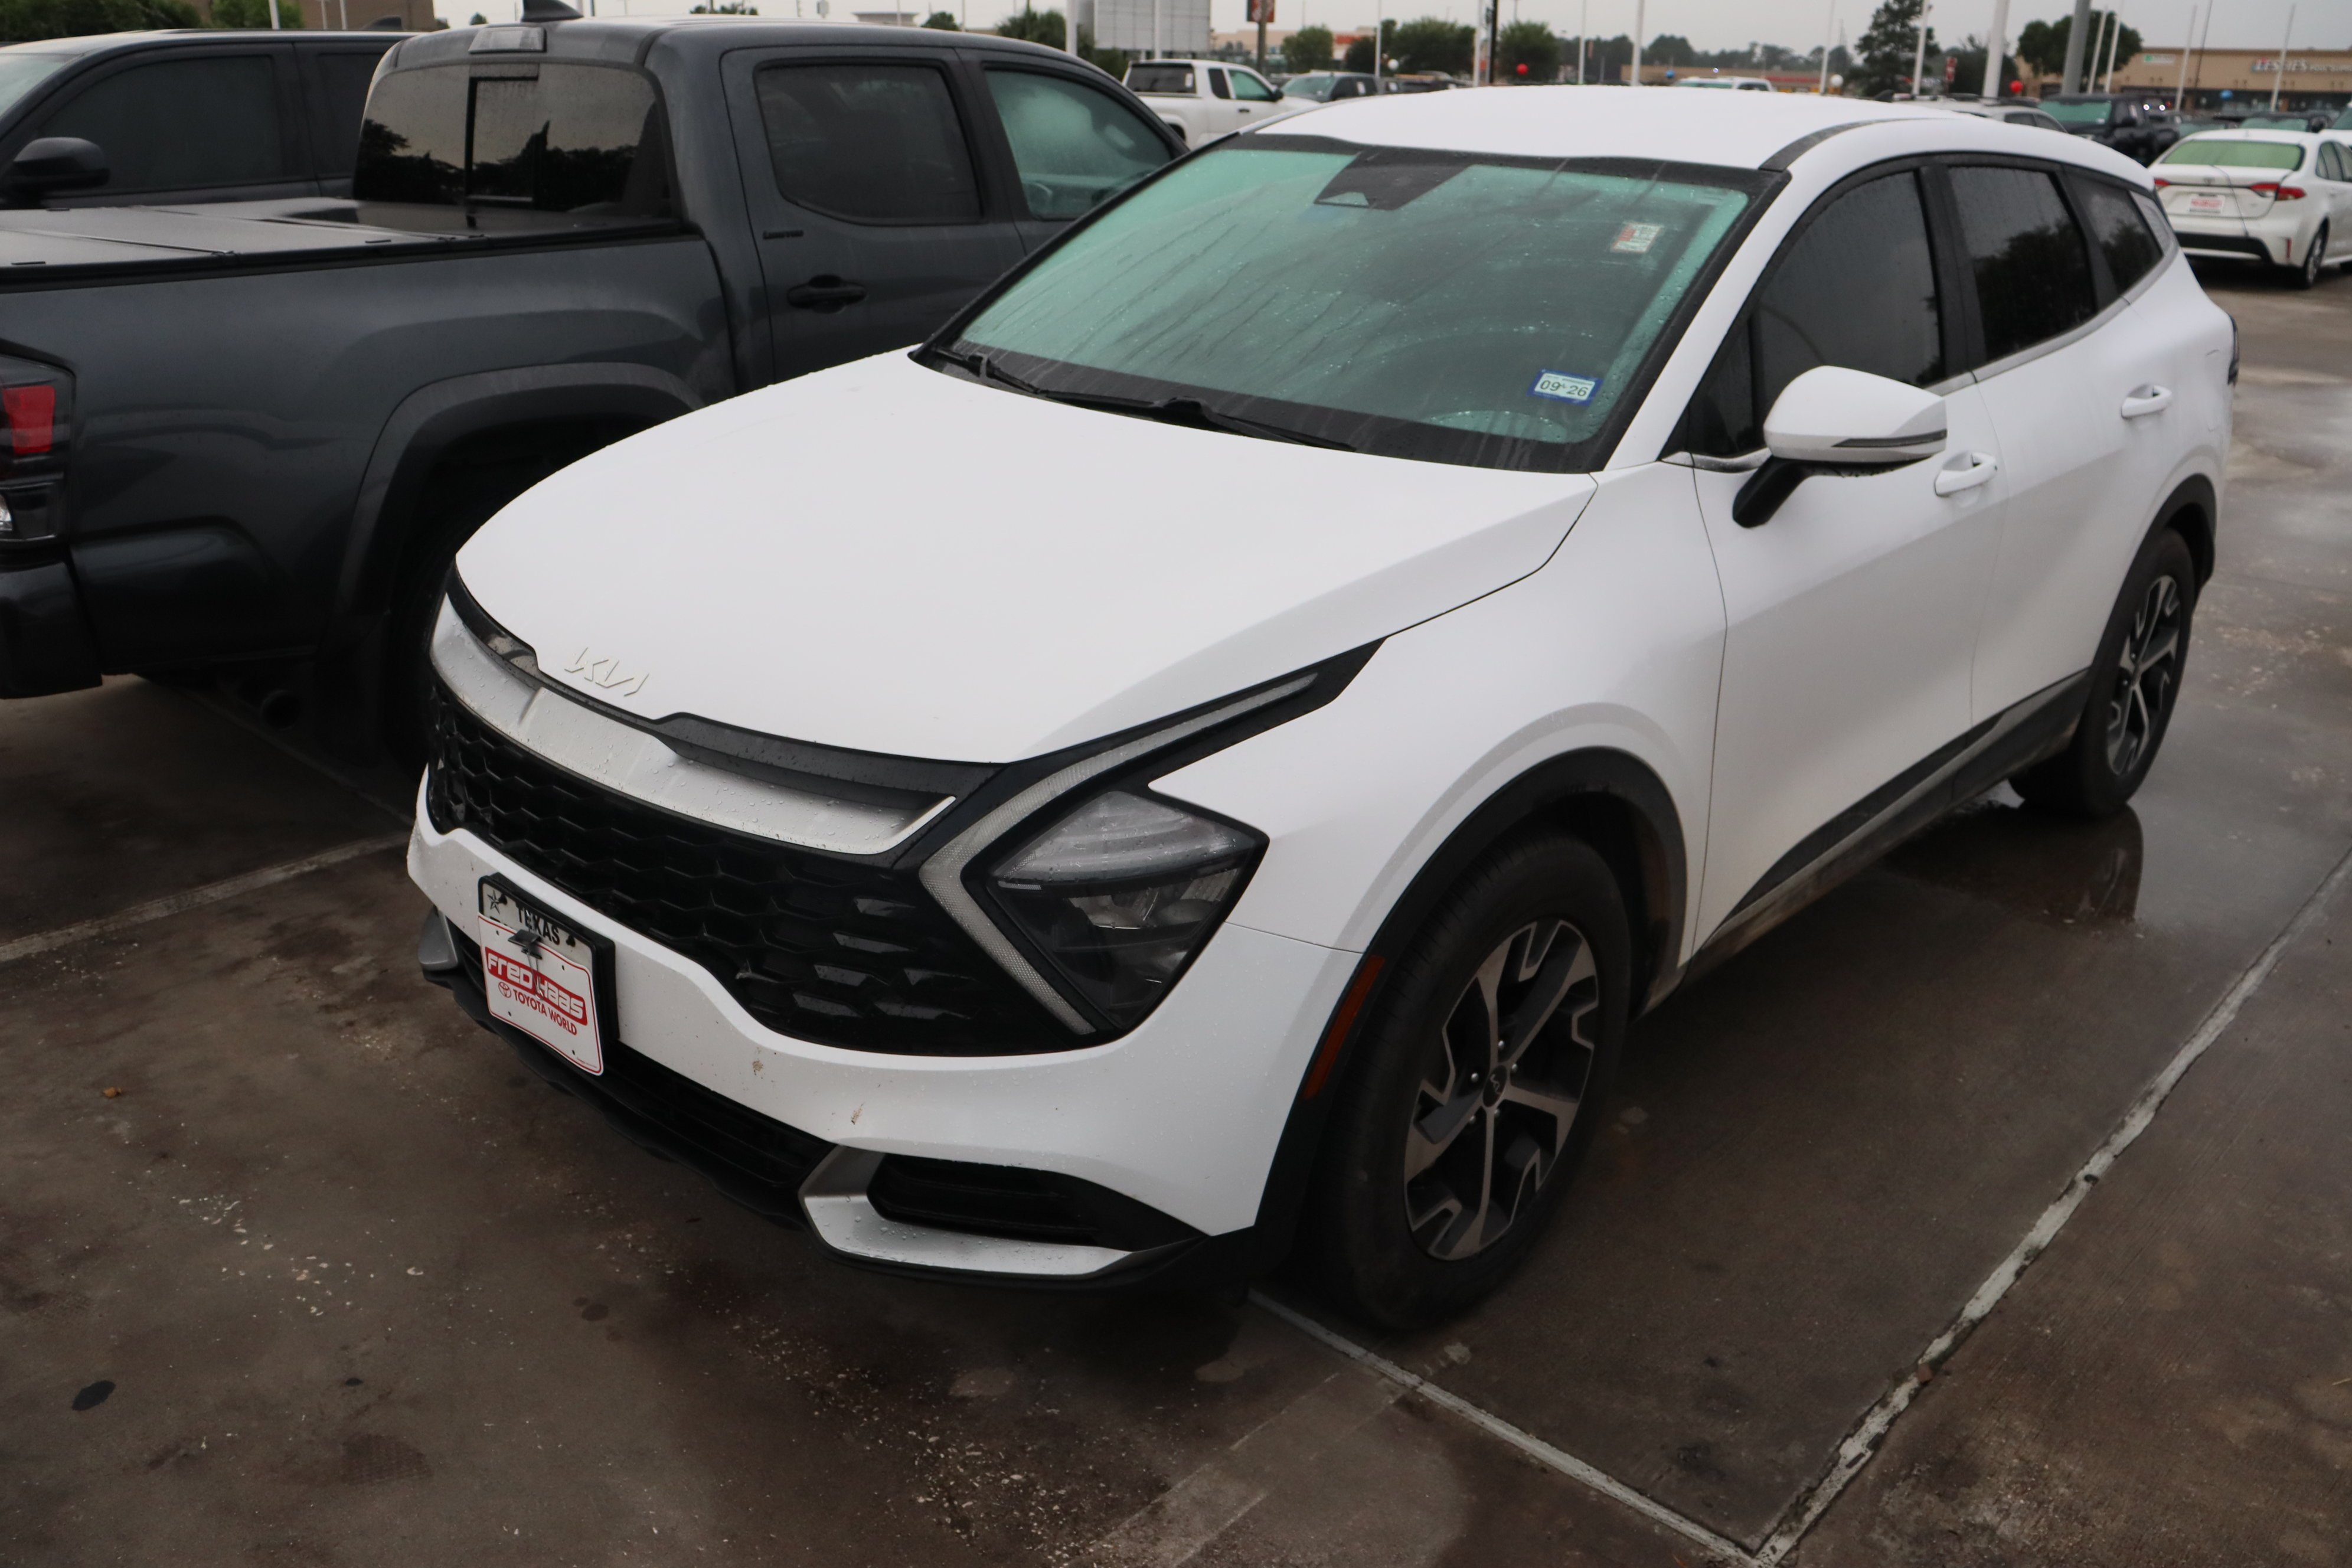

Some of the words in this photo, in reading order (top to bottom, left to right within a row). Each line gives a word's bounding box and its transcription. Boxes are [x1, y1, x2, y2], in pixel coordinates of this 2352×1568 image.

[1540, 380, 1561, 391] 09
[1566, 385, 1589, 397] 26
[515, 901, 560, 945] TEXAS
[513, 989, 547, 1017] TOYOTA
[548, 1007, 577, 1035] WORLD
